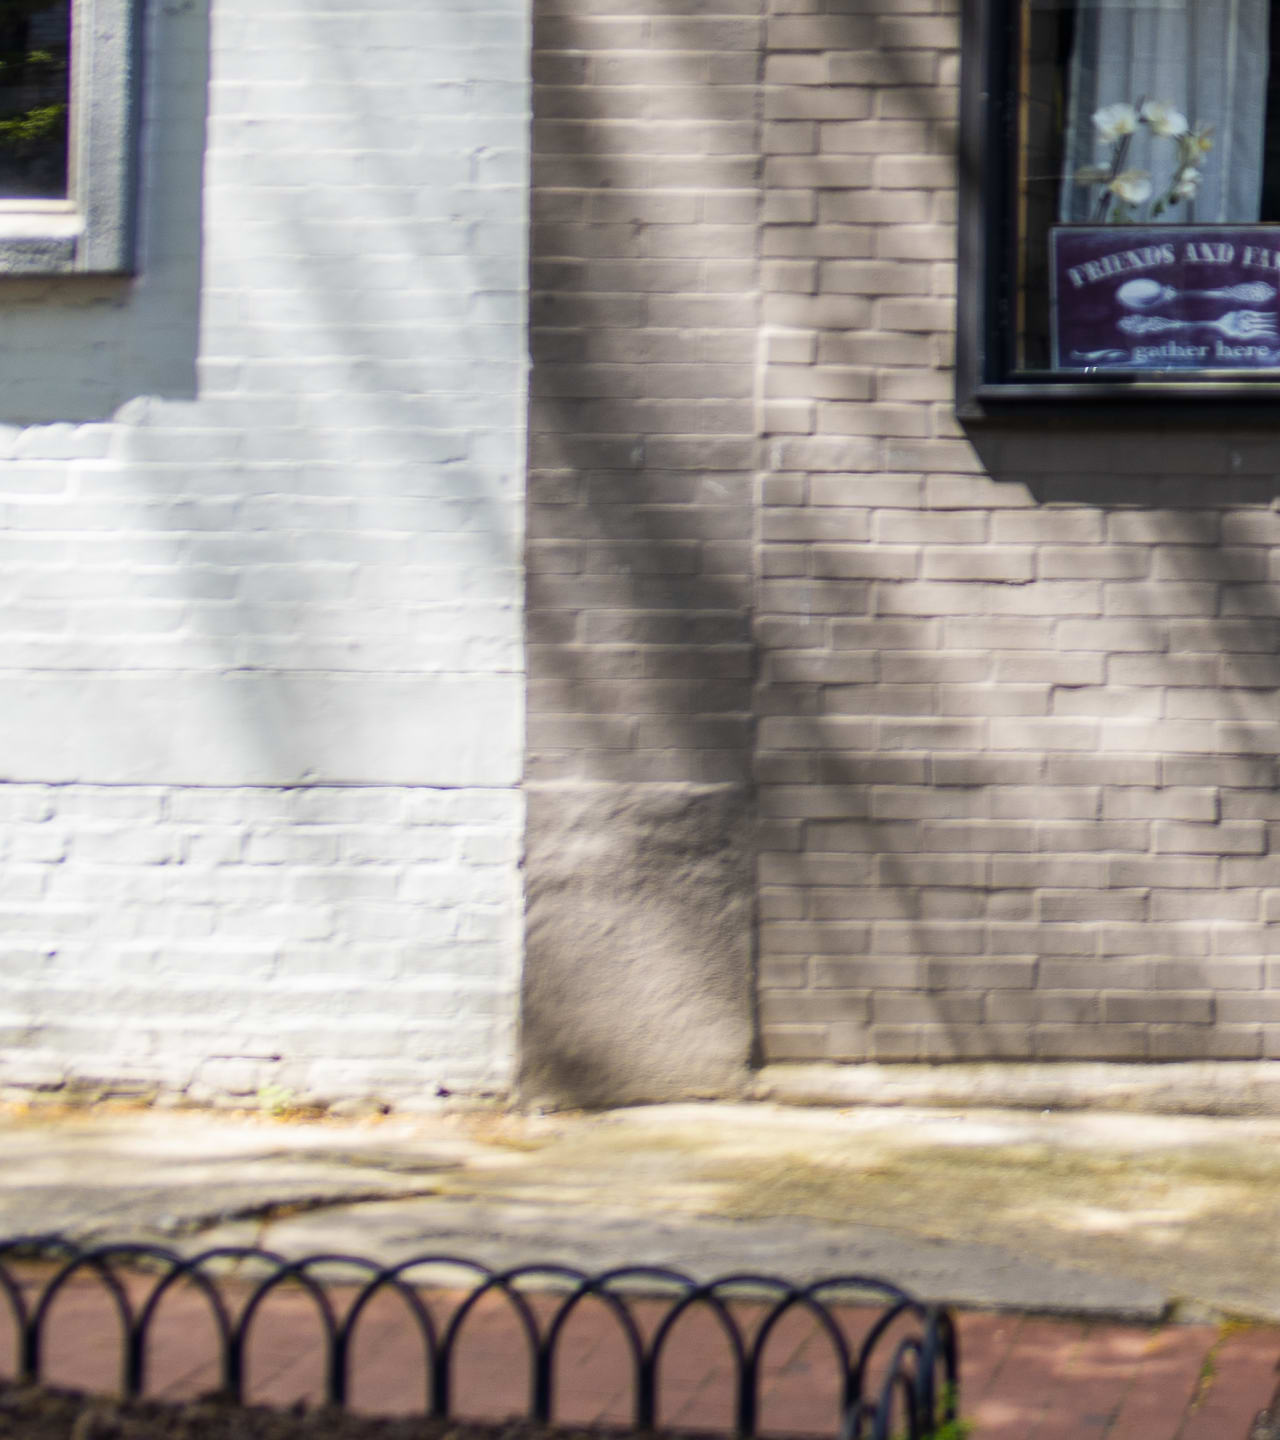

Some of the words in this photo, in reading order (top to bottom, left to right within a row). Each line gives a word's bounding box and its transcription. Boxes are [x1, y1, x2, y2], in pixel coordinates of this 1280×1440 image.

[1067, 243, 1176, 288] FRIENDS
[1183, 242, 1236, 264] AND
[1134, 340, 1209, 361] gather
[1214, 340, 1271, 358] here
